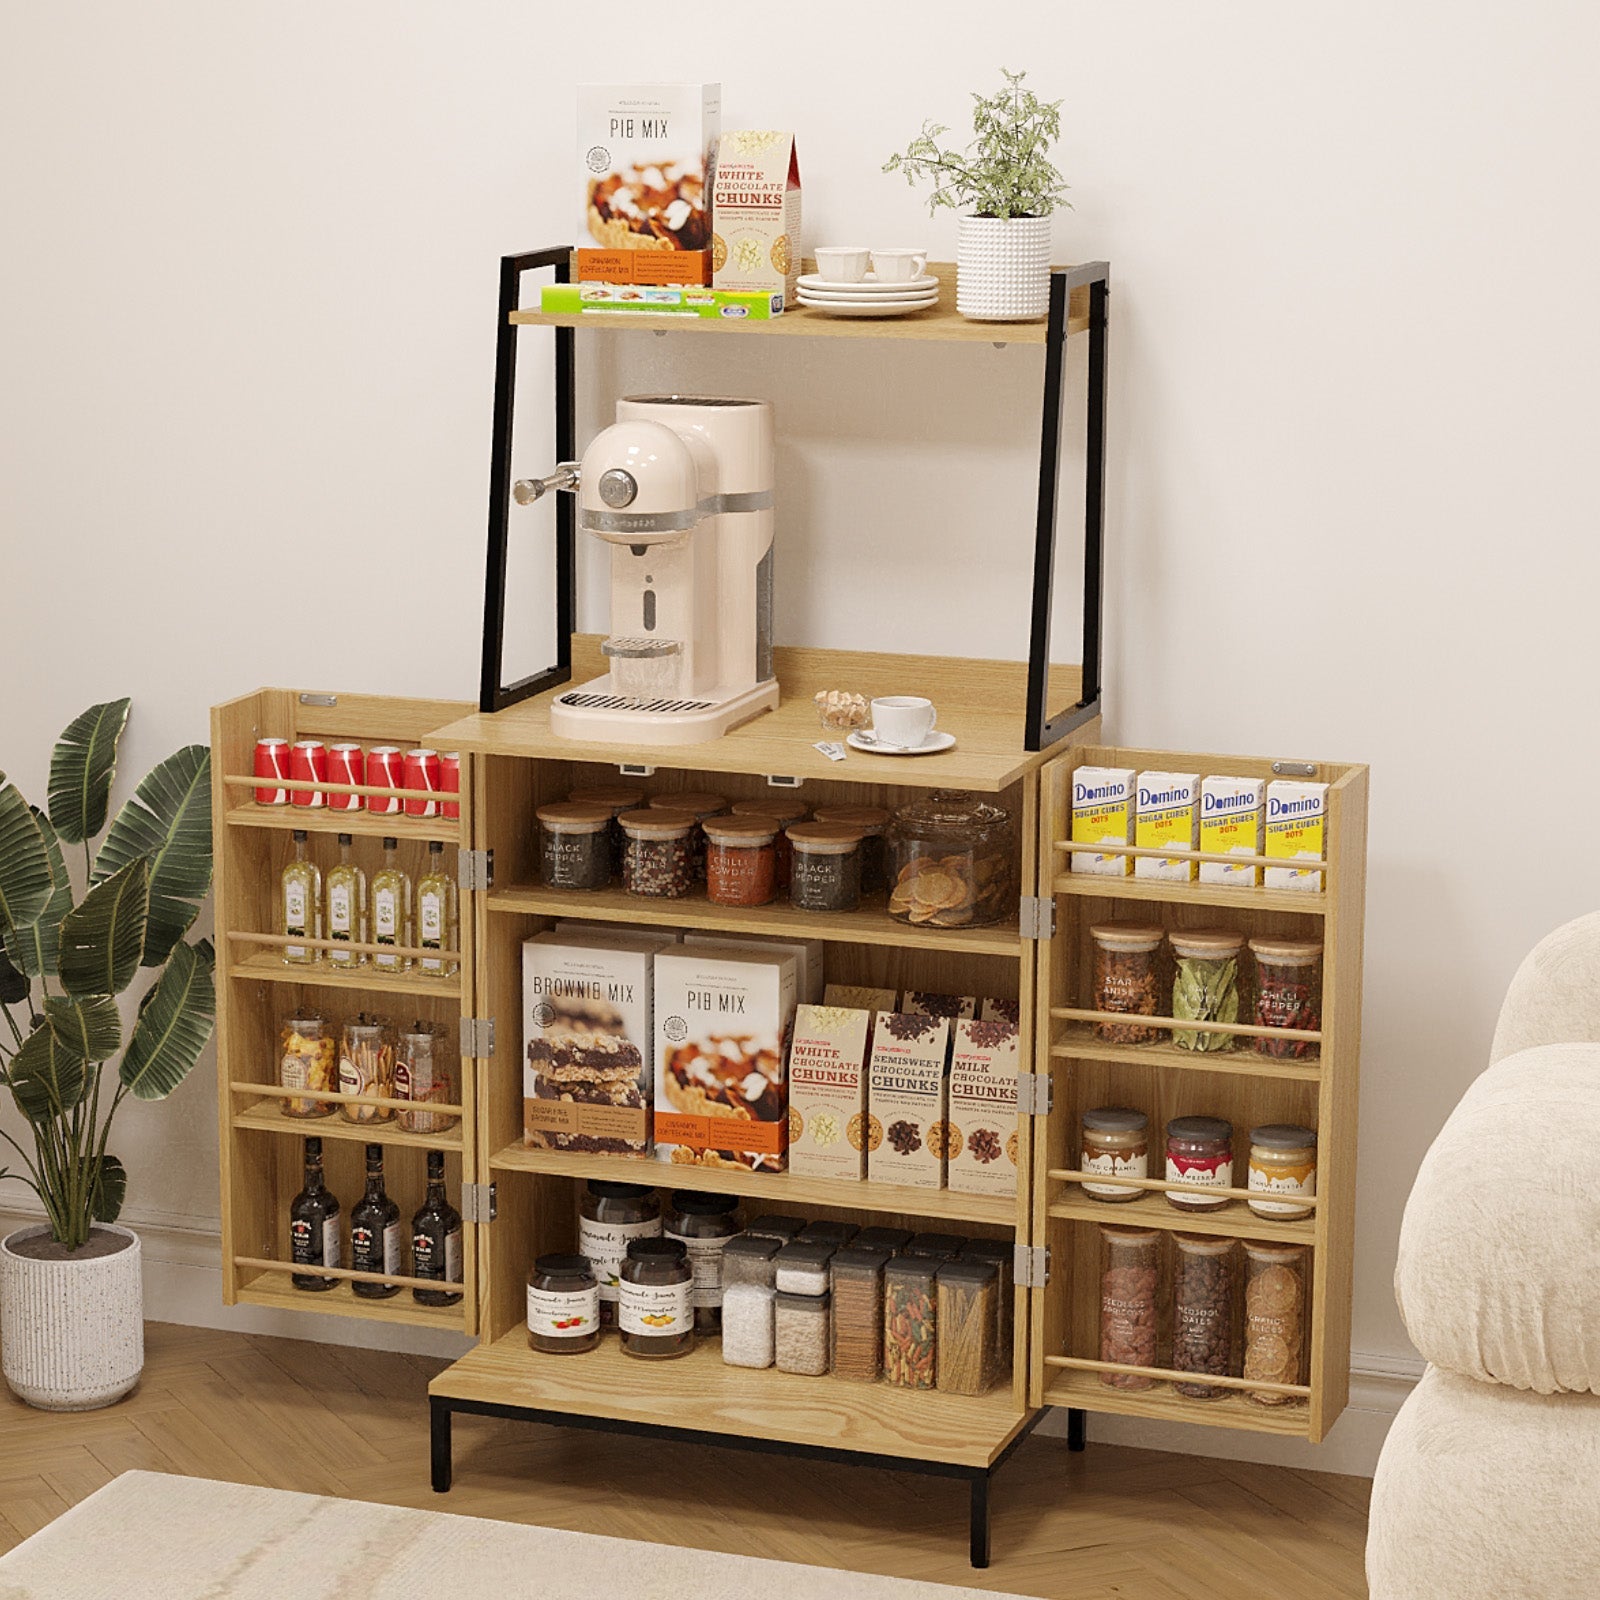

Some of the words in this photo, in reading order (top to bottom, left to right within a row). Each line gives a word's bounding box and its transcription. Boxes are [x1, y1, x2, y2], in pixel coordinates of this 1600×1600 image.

[642, 119, 668, 139] MIX
[718, 171, 764, 181] WHITE
[716, 182, 784, 192] CHOCOLATE
[715, 193, 782, 205] CHUNKS
[1074, 781, 1125, 802] Domino
[1139, 785, 1190, 806] Domino
[1203, 790, 1255, 811] Domino
[1268, 795, 1320, 816] Domino
[1075, 809, 1100, 819] SUGAR
[1101, 803, 1125, 815] CUBES
[1138, 814, 1163, 824] SUGAR
[1166, 809, 1190, 820] CUBES
[1091, 815, 1109, 824] DOTS
[1155, 820, 1173, 829] DOTS
[1203, 819, 1229, 829] SUGAR
[1230, 814, 1255, 825] CUBES
[1268, 824, 1294, 834] SUGAR
[1295, 818, 1320, 829] CUBES
[1219, 825, 1239, 834] DOTS
[1285, 830, 1304, 839] DOTS
[798, 862, 832, 873] BLACK
[1105, 976, 1132, 986] STAR
[608, 983, 634, 1004] MIX
[719, 993, 745, 1014] MIX
[794, 1046, 840, 1059] WHITE
[793, 1057, 860, 1071] CHOCOLATE
[874, 1055, 941, 1068] SEMISWEET
[954, 1061, 990, 1073] MILK
[792, 1067, 858, 1084] CHUNKS
[873, 1065, 940, 1079] CHOCOLATE
[872, 1076, 939, 1092] CHUNKS
[953, 1073, 1019, 1087] CHOCOLATE
[952, 1083, 1018, 1100] CHUNKS
